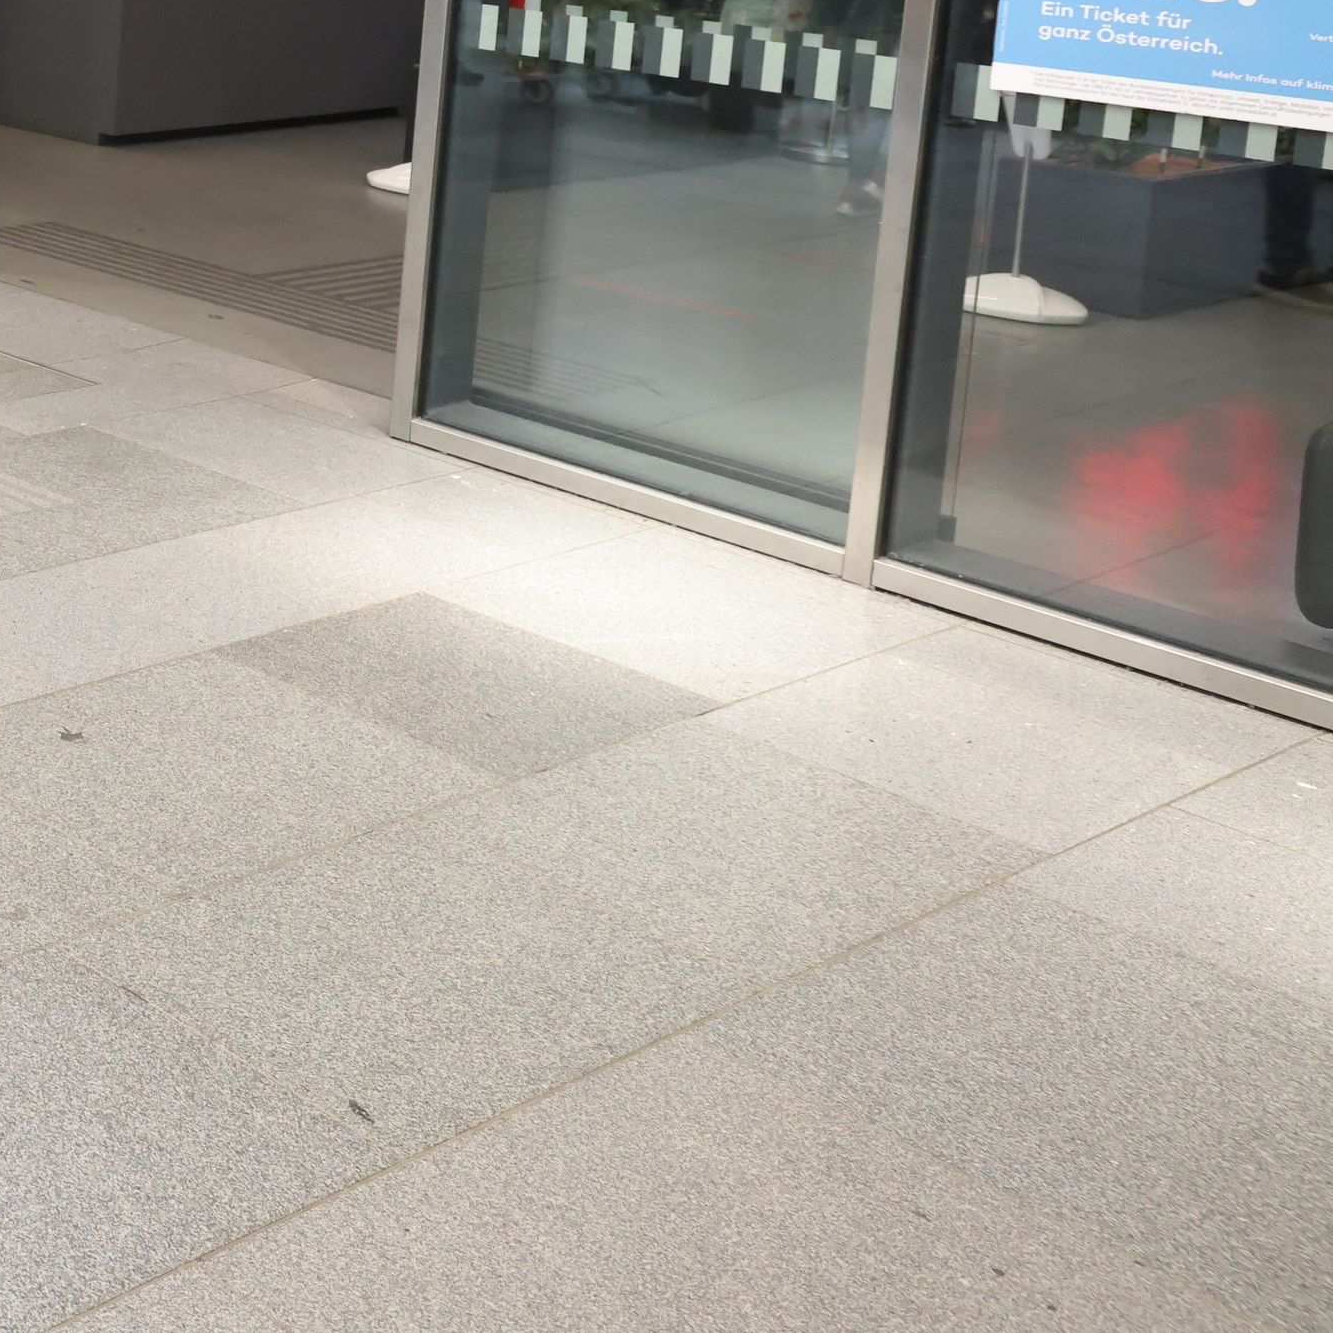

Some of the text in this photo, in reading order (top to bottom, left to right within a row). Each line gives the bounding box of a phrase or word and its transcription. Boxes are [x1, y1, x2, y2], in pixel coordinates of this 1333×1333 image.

[1041, 1, 1192, 30] Ein Ticket für
[1038, 24, 1224, 56] ganz Österreich.
[1211, 69, 1244, 82] Mehr
[1245, 73, 1278, 85] Infos
[1280, 78, 1305, 88] auf
